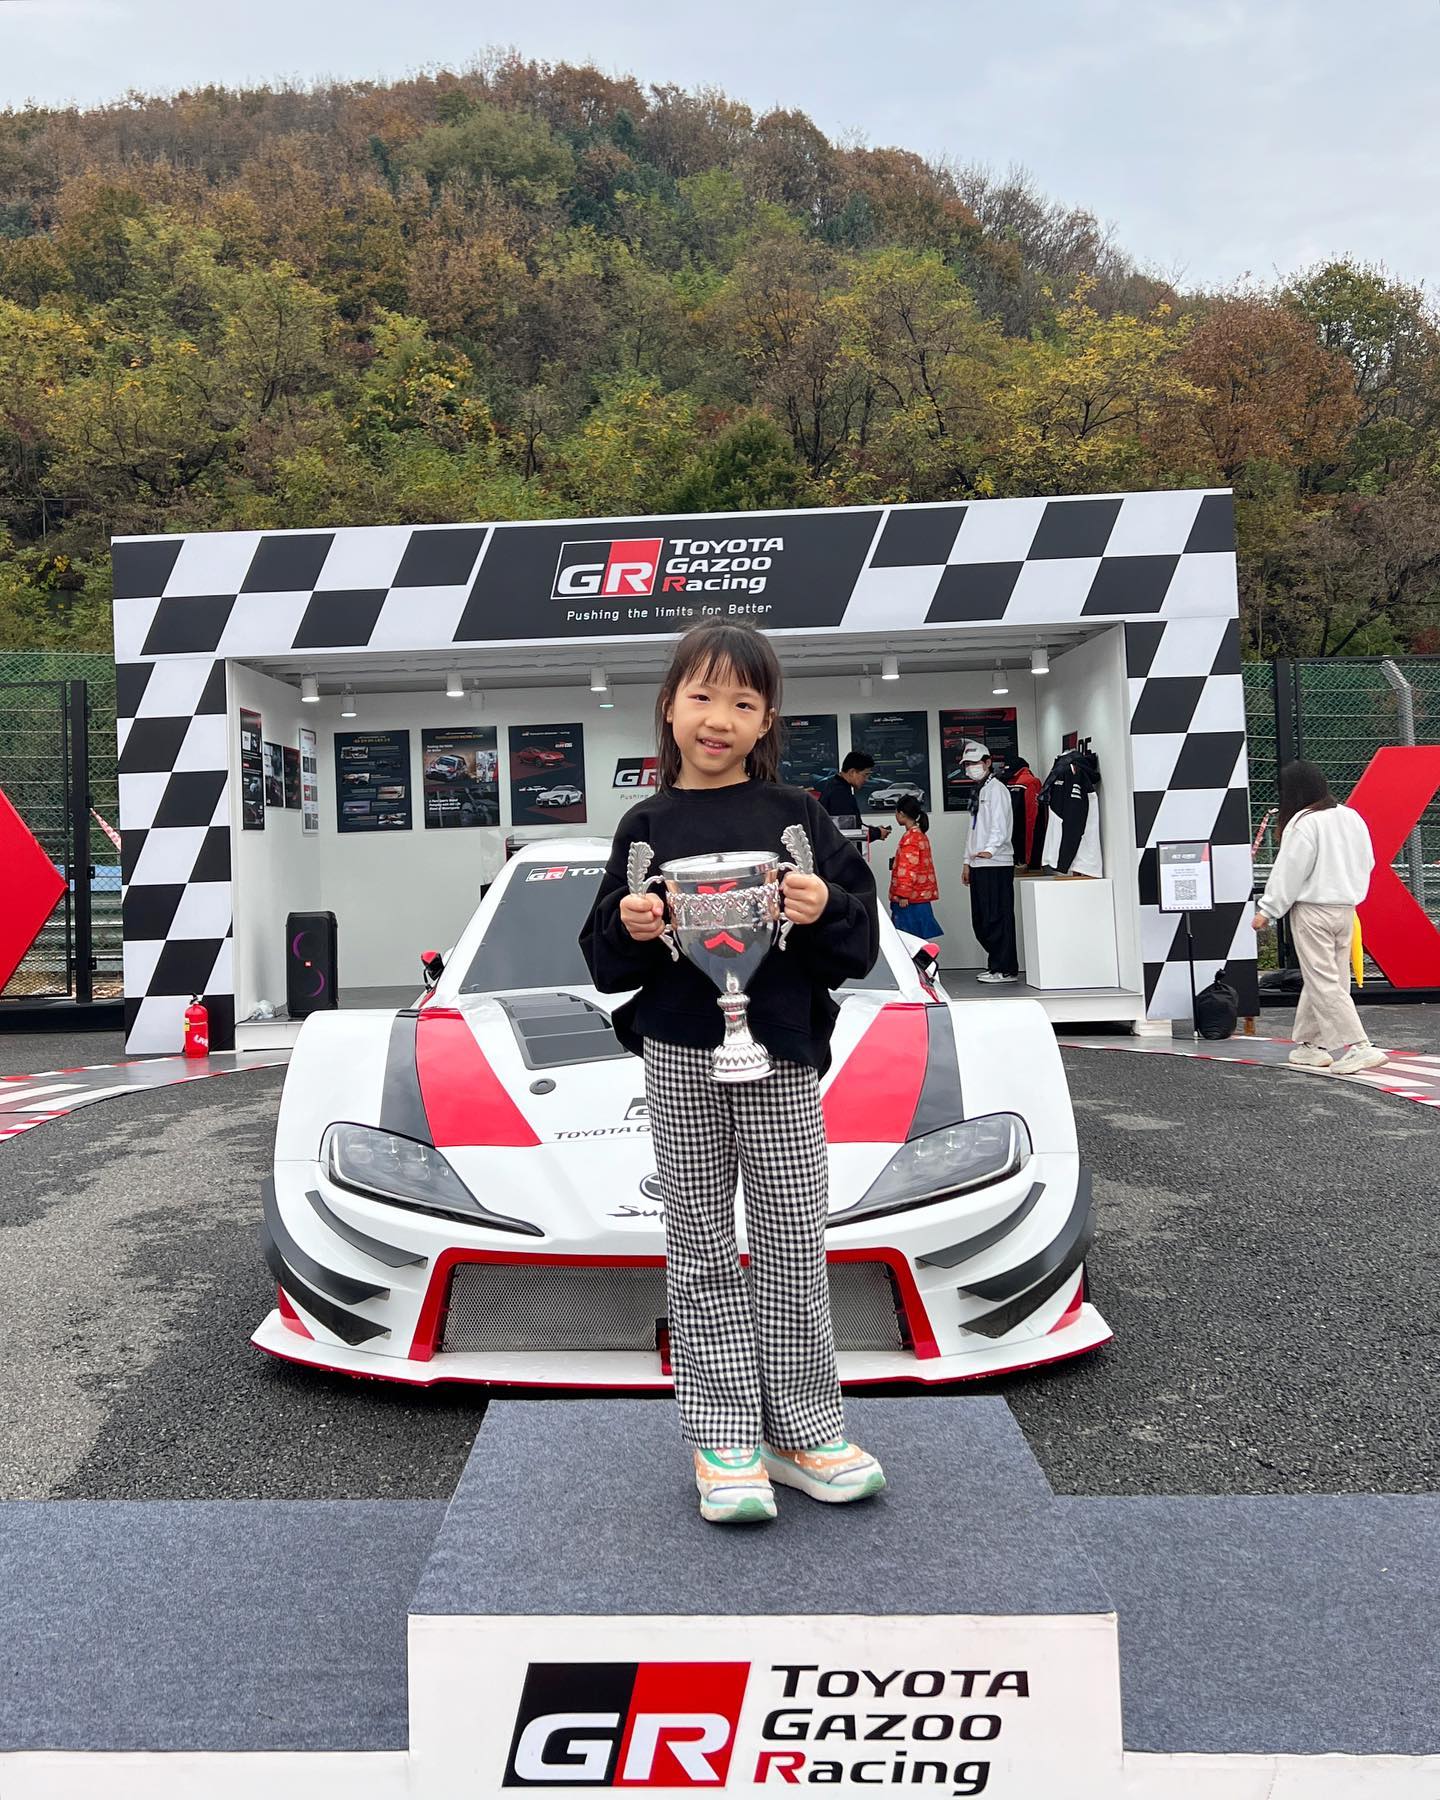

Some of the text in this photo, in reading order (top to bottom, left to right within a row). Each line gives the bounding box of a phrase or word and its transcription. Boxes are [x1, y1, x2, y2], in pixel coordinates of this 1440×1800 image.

[669, 537, 784, 556] TOYOTA
[665, 556, 772, 574] GAZOO
[557, 561, 653, 595] GR
[662, 574, 767, 594] Racing
[566, 604, 772, 622] Pushing the limits for Better
[528, 871, 562, 881] GR
[554, 1126, 631, 1140] TOYOTA
[771, 1664, 1030, 1698] TOYOTA
[761, 1708, 1003, 1741] GAZOO
[514, 1712, 731, 1781] GR
[753, 1750, 992, 1796] Racing
